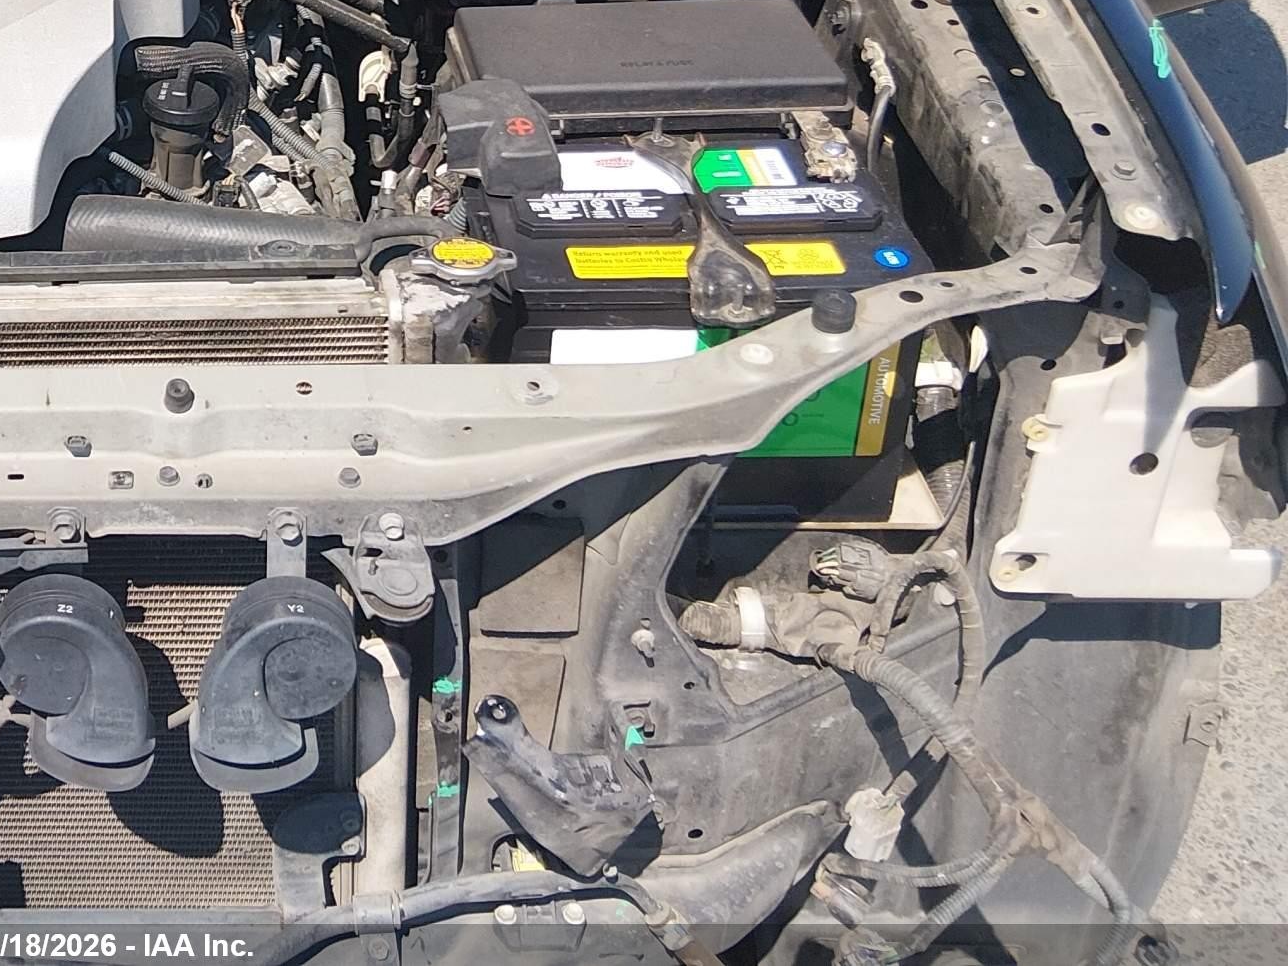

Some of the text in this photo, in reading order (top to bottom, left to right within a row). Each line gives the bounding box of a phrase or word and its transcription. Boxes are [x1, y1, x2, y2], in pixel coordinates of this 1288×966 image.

[868, 357, 891, 426] AUTOMOTIVE
[57, 604, 73, 614] Z2
[287, 604, 305, 613] Y2
